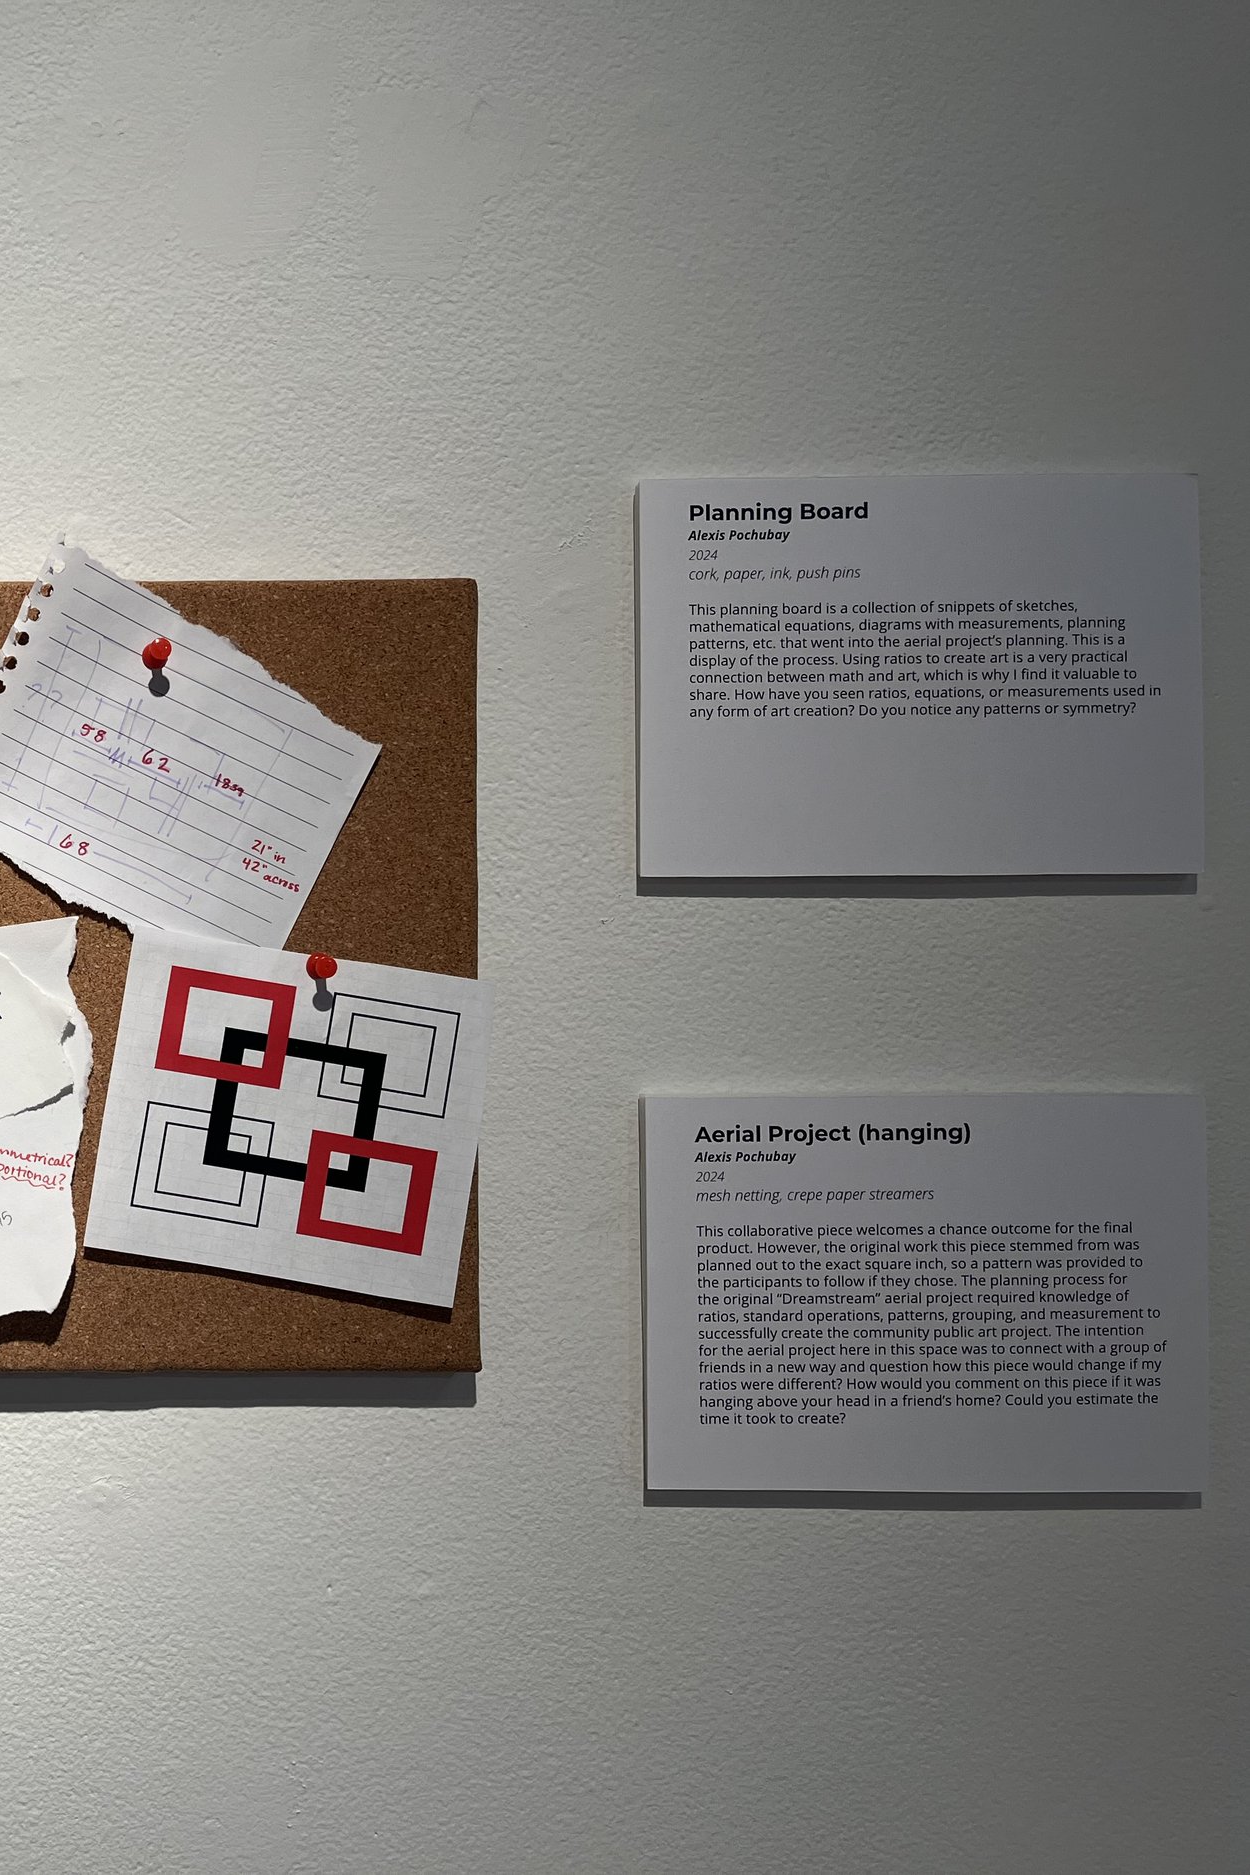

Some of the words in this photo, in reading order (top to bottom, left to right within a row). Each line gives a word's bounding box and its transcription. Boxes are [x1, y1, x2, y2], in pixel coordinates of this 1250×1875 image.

[690, 502, 792, 524] Planning
[800, 502, 868, 520] Board
[688, 530, 725, 541] Alexis
[729, 529, 790, 543] Pochubay
[689, 550, 718, 560] 2024
[689, 568, 719, 582] cork,
[723, 570, 765, 583] paper,
[770, 566, 792, 580] ink,
[796, 566, 829, 582] push
[832, 566, 861, 582] pins
[689, 604, 716, 615] This
[720, 603, 778, 618] planning
[782, 602, 821, 614] board
[826, 602, 836, 614] is
[840, 605, 848, 614] a
[852, 602, 916, 614] collection
[920, 601, 934, 612] of
[938, 601, 995, 615] snippets
[999, 600, 1013, 612] of
[1016, 600, 1077, 613] sketches,
[690, 620, 780, 632] mathematical
[785, 620, 854, 635] equations,
[859, 619, 921, 634] diagrams
[925, 618, 954, 630] with
[959, 618, 1063, 630] measurements,
[1068, 616, 1125, 632] planning
[690, 708, 714, 720] any
[717, 705, 749, 717] form
[754, 705, 768, 717] of
[771, 706, 790, 716] art
[794, 705, 854, 716] creation?
[859, 705, 877, 716] Do
[881, 707, 906, 719] you
[911, 704, 951, 715] notice
[956, 706, 980, 718] any
[984, 704, 1040, 718] patterns
[1045, 705, 1059, 714] or
[1063, 702, 1136, 717] symmetry?
[80, 723, 107, 743] 58
[141, 748, 171, 773] 62
[59, 833, 90, 856] 68
[274, 851, 286, 864] in
[263, 874, 300, 893] across
[694, 1124, 760, 1143] Aerial
[769, 1123, 851, 1146] Project
[859, 1122, 970, 1145] (hanging)
[694, 1151, 732, 1162] Alexis
[736, 1150, 796, 1164] Pochubay
[696, 1171, 725, 1182] 2024
[696, 1189, 730, 1202] mesh
[735, 1189, 782, 1204] netting,
[788, 1191, 822, 1204] crepe
[826, 1191, 866, 1204] paper
[869, 1189, 934, 1200] streamers
[698, 1242, 752, 1257] product.
[758, 1242, 820, 1255] However,
[824, 1241, 846, 1253] the
[850, 1240, 900, 1256] original
[904, 1240, 938, 1252] work
[942, 1240, 966, 1252] this
[970, 1240, 1006, 1255] piece
[1010, 1239, 1072, 1251] stemmed
[1077, 1239, 1109, 1251] from
[1114, 1241, 1139, 1250] was
[700, 1413, 729, 1424] time
[734, 1413, 742, 1424] it
[746, 1412, 776, 1424] took
[780, 1414, 793, 1424] to
[798, 1413, 846, 1424] create?
